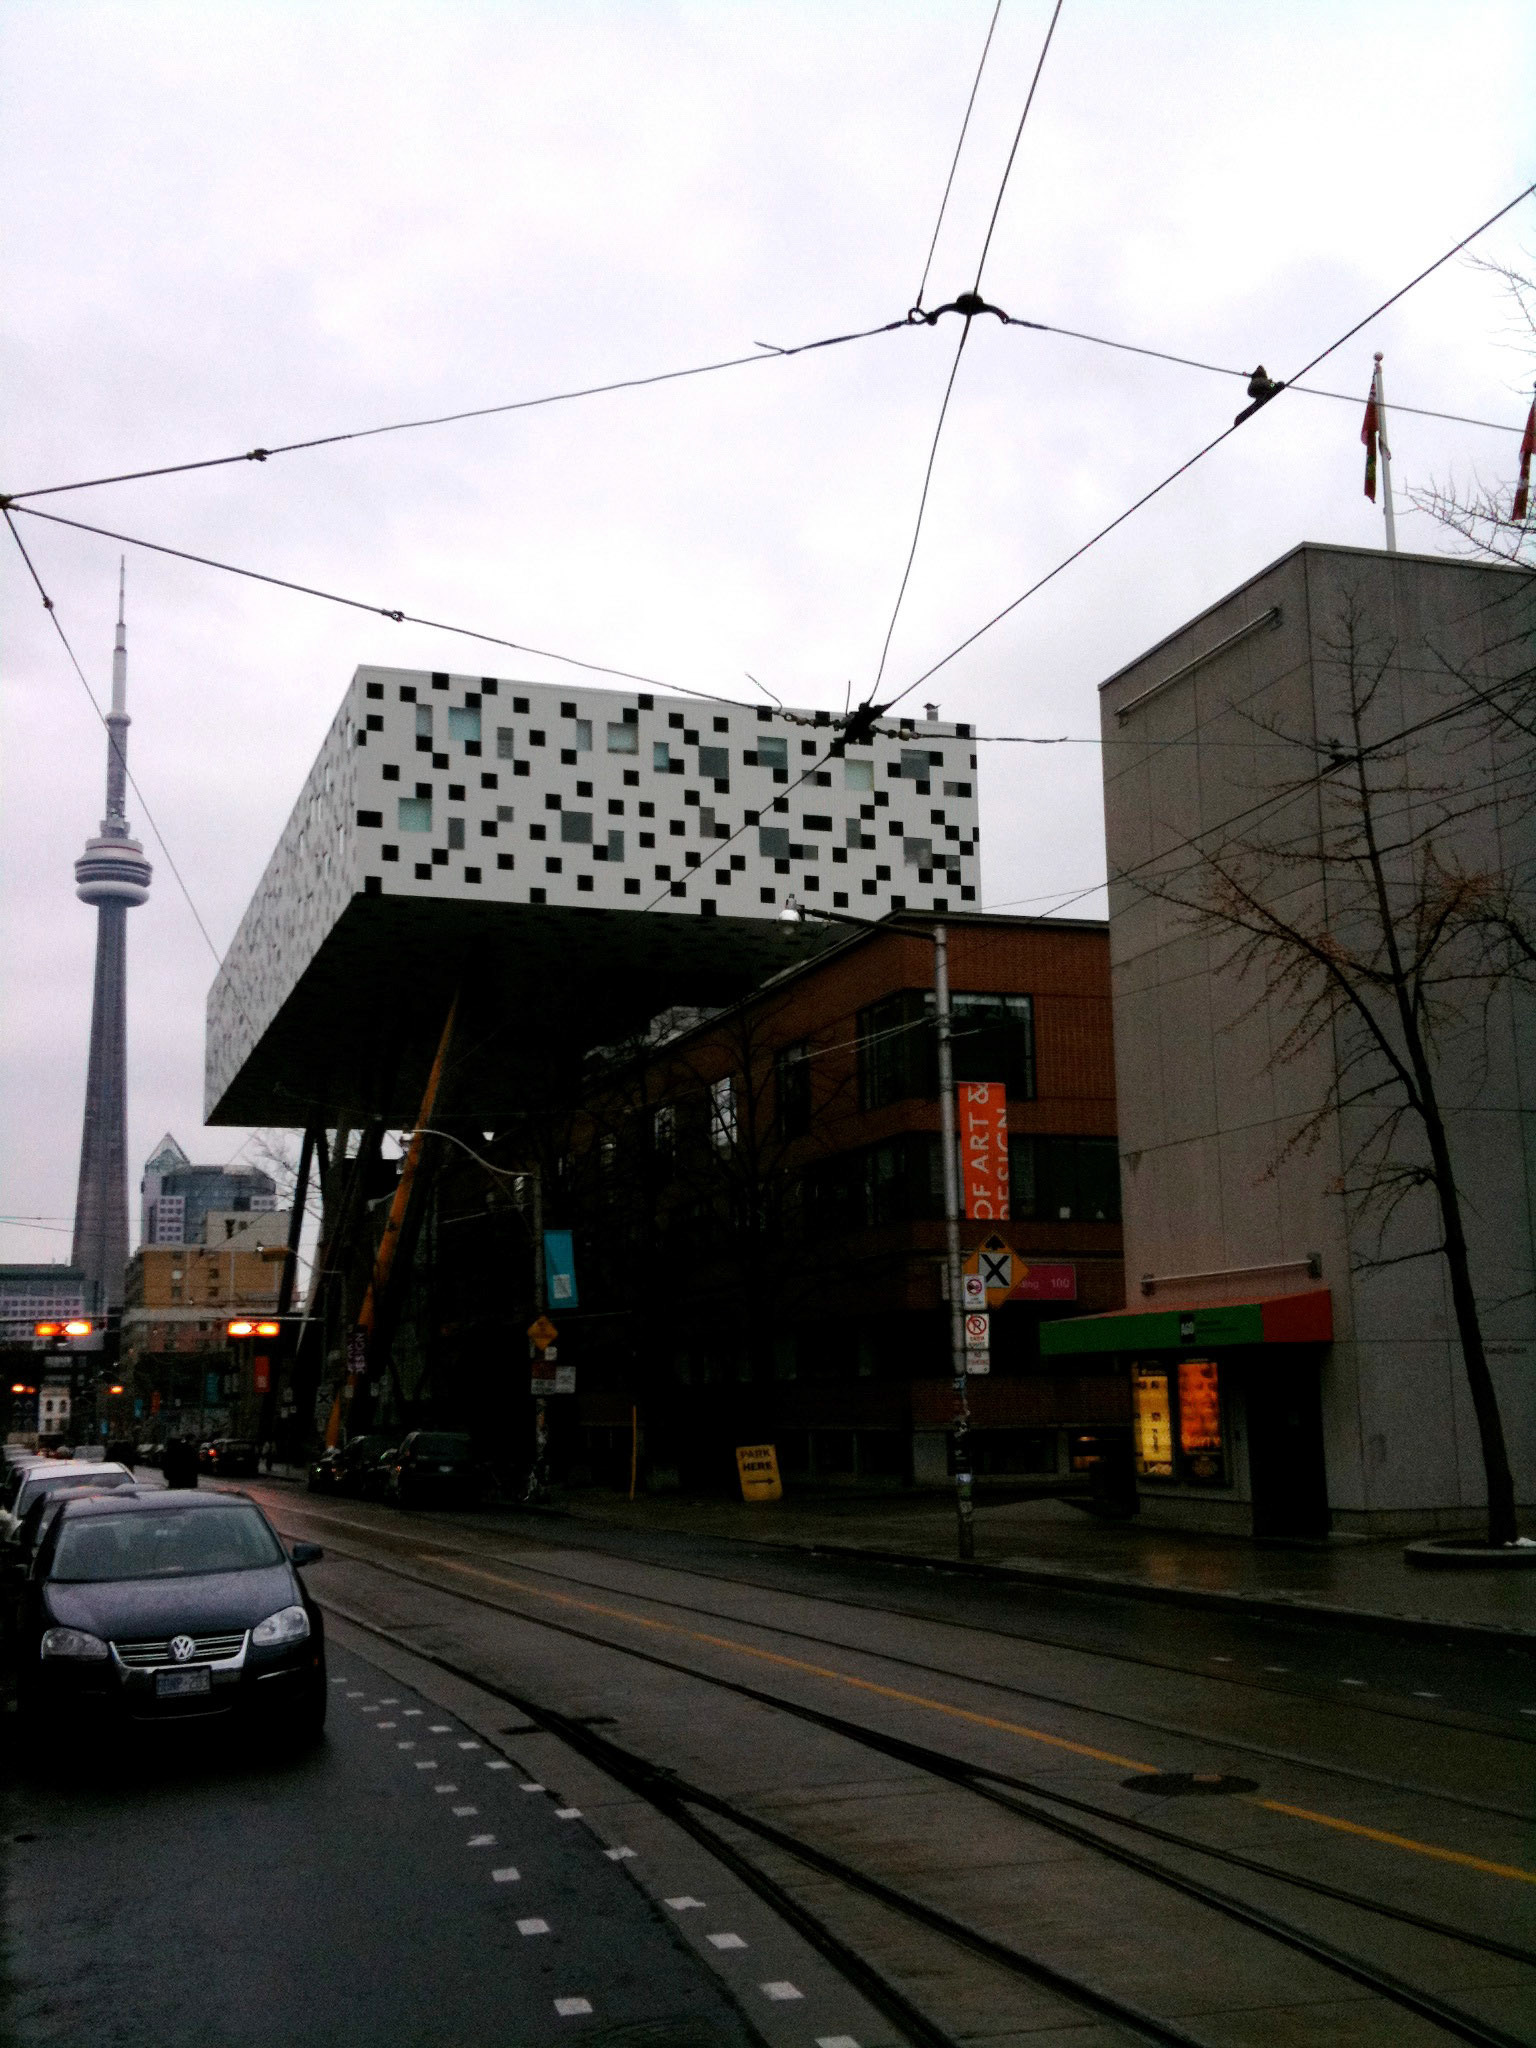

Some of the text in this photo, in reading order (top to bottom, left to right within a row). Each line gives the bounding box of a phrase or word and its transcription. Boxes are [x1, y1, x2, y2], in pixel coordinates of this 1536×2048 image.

[967, 1083, 993, 1220] OF ART &
[740, 1449, 770, 1459] PARK
[743, 1461, 772, 1471] HERE
